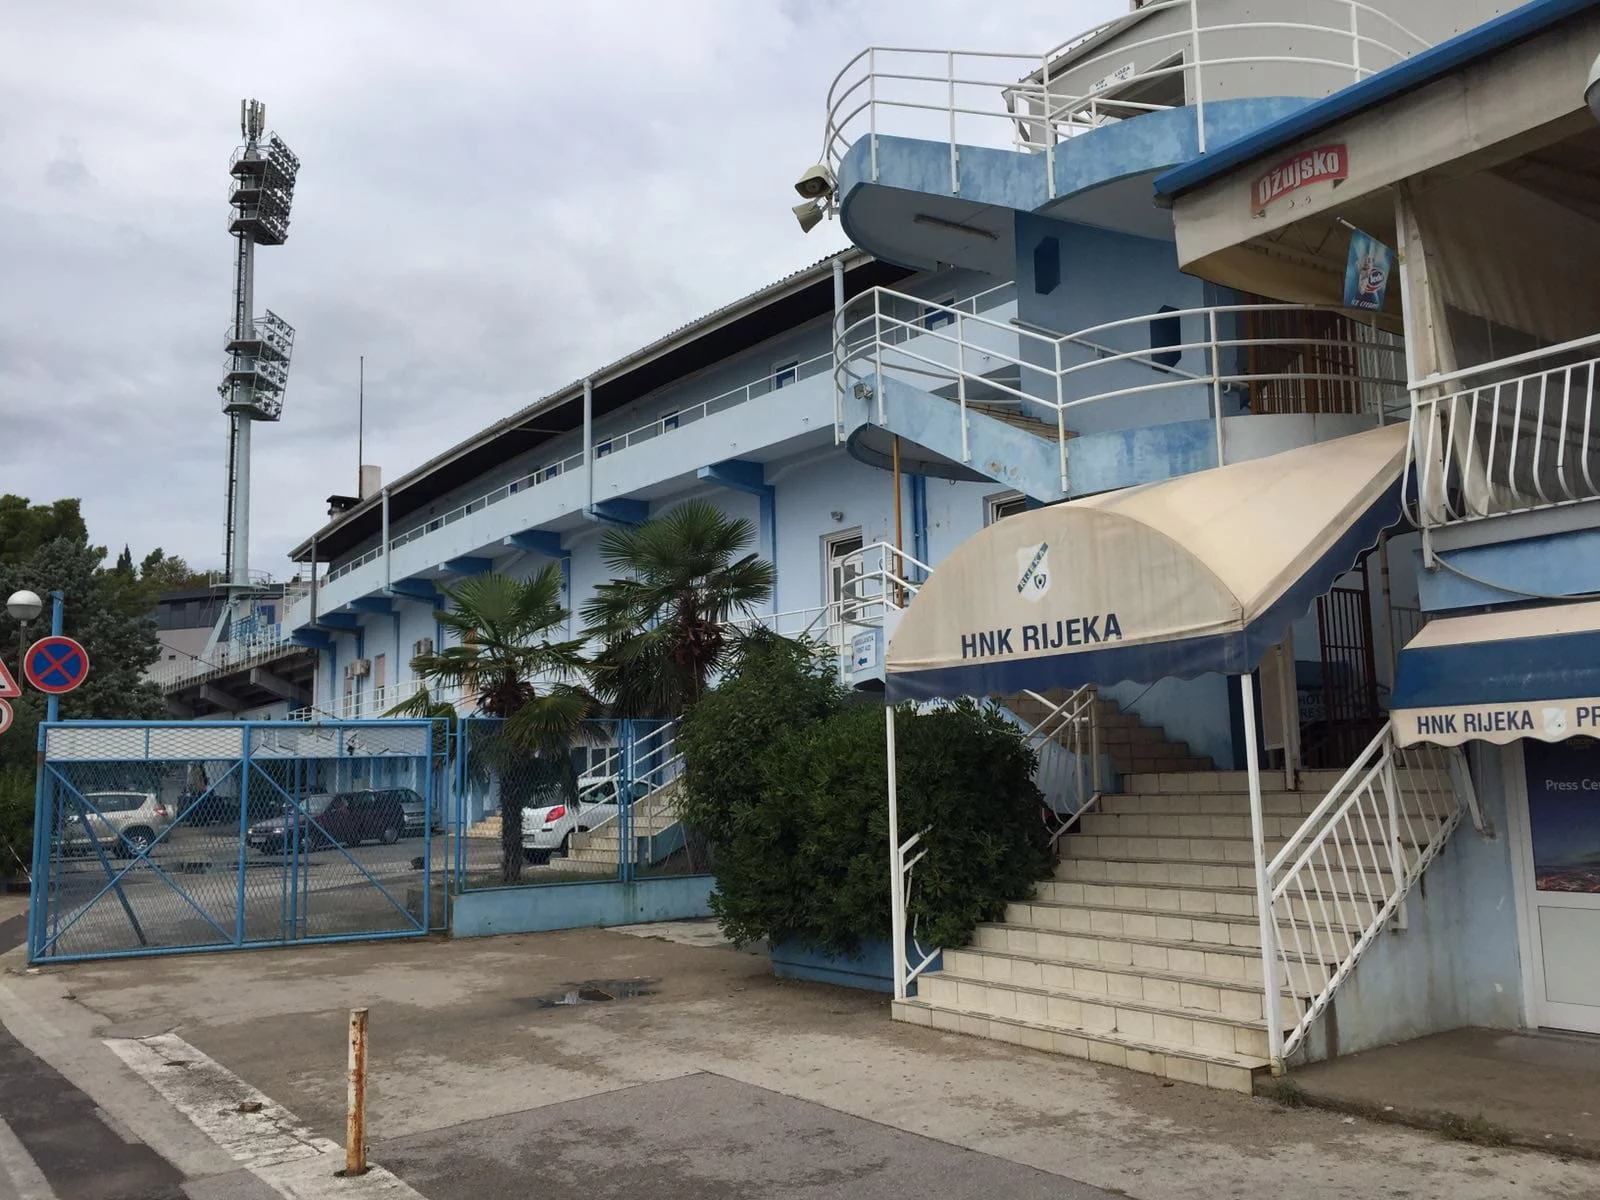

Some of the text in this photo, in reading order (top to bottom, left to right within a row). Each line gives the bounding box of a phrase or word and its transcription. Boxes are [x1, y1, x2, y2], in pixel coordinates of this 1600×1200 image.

[961, 613, 1122, 659] HNK RIJEKA
[1417, 713, 1457, 734] HNK
[1464, 710, 1534, 732] RIJEKA
[1545, 778, 1600, 791] Press Ce
